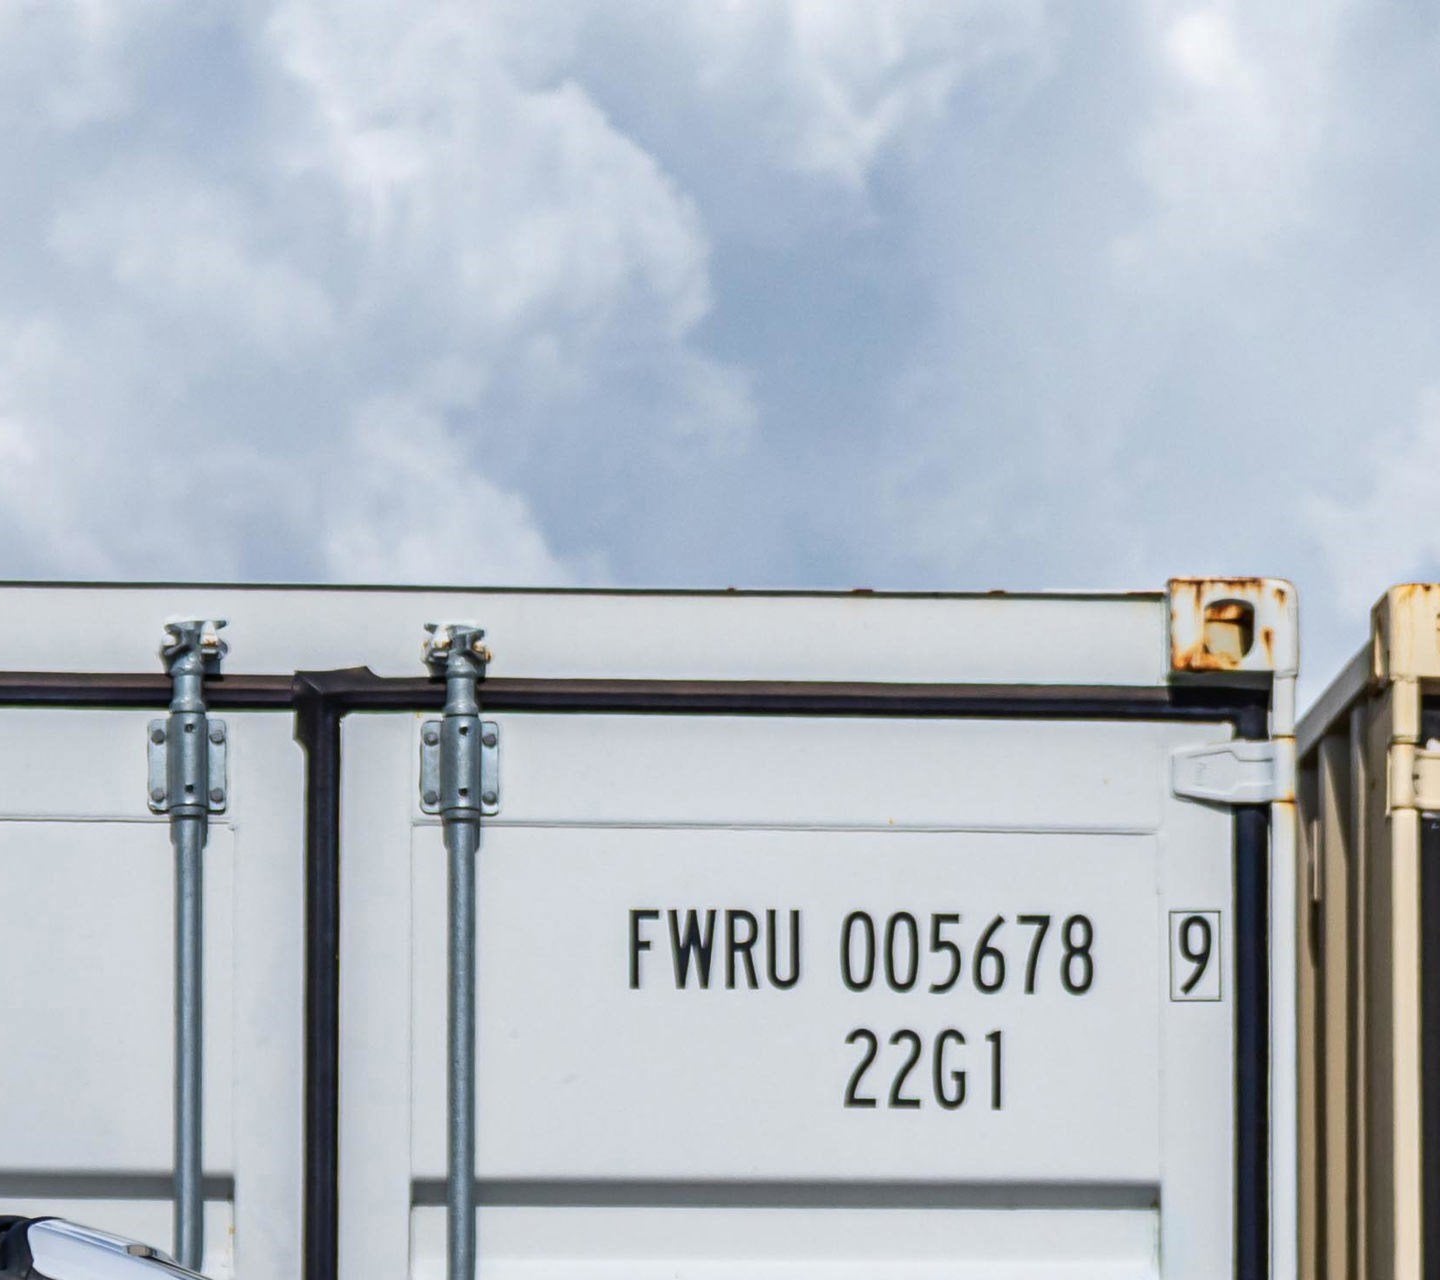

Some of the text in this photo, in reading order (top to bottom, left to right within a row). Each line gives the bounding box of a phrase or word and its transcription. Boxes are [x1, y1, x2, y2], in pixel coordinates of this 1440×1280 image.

[628, 909, 1213, 995] FWRU 005678 9
[844, 1028, 1003, 1110] 22G1
